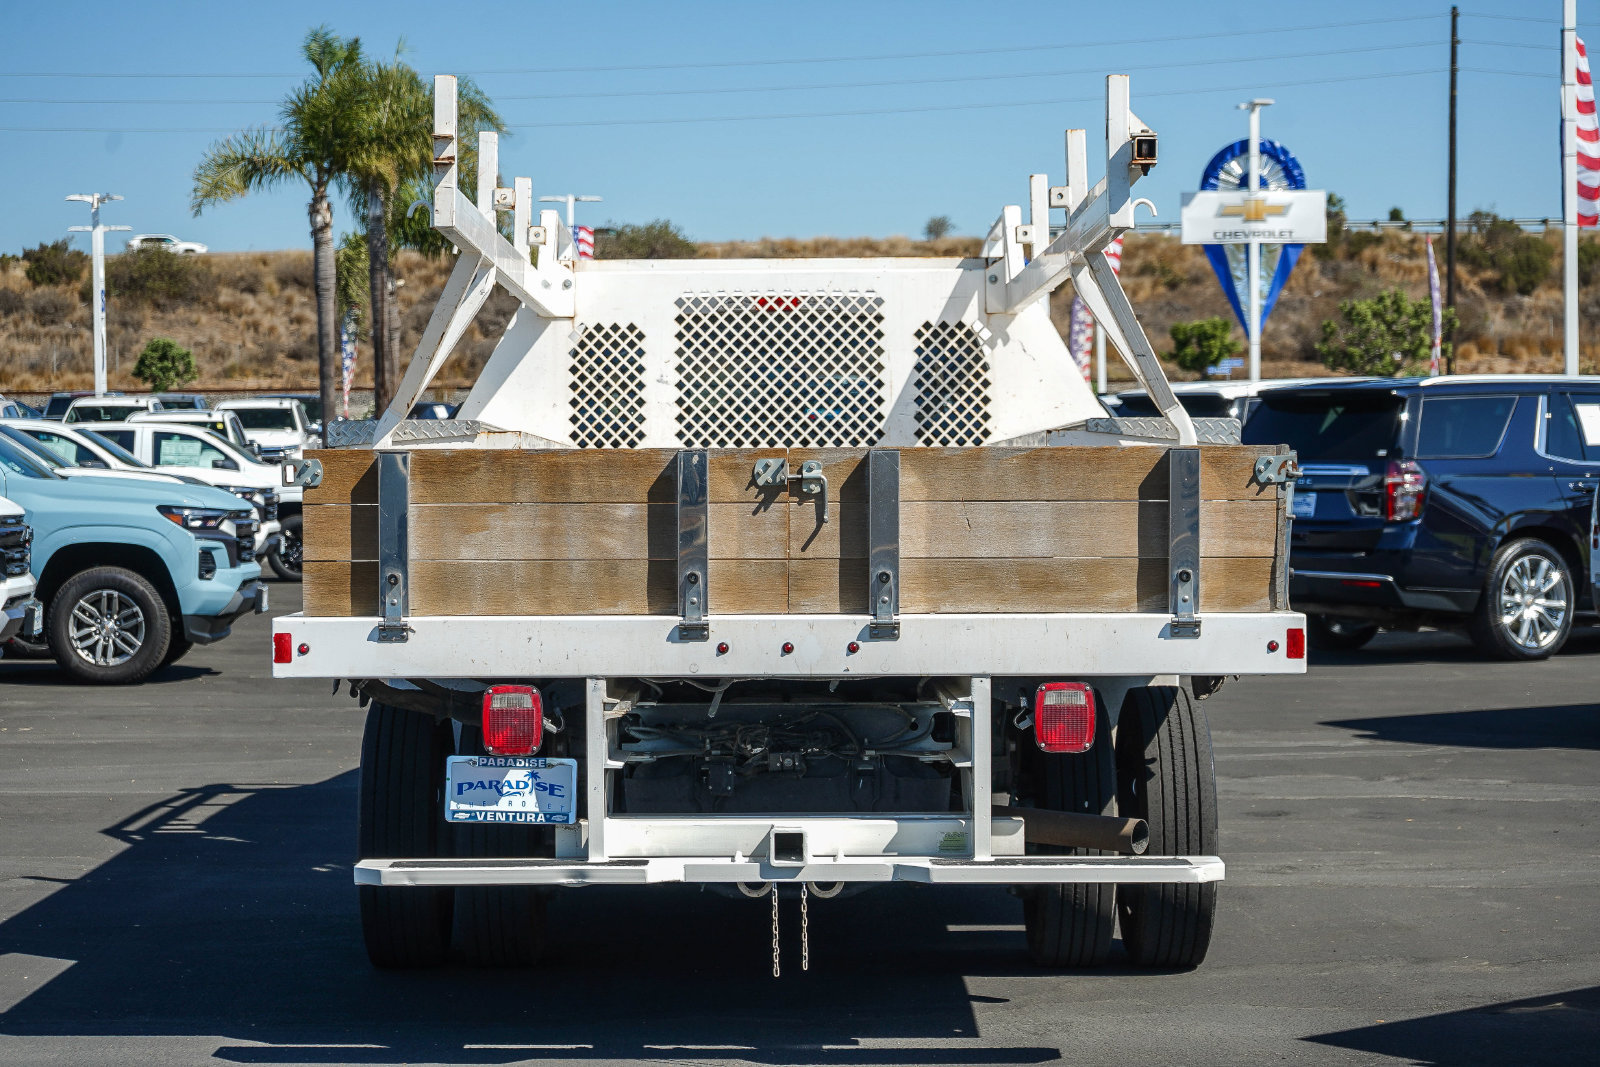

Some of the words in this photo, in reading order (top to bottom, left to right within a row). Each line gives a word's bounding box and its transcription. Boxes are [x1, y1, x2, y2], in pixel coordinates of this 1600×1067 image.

[1213, 230, 1295, 240] CHEVROLET
[479, 757, 546, 769] PARADISE
[457, 773, 565, 798] PARADISE
[475, 811, 546, 823] VENTURA
